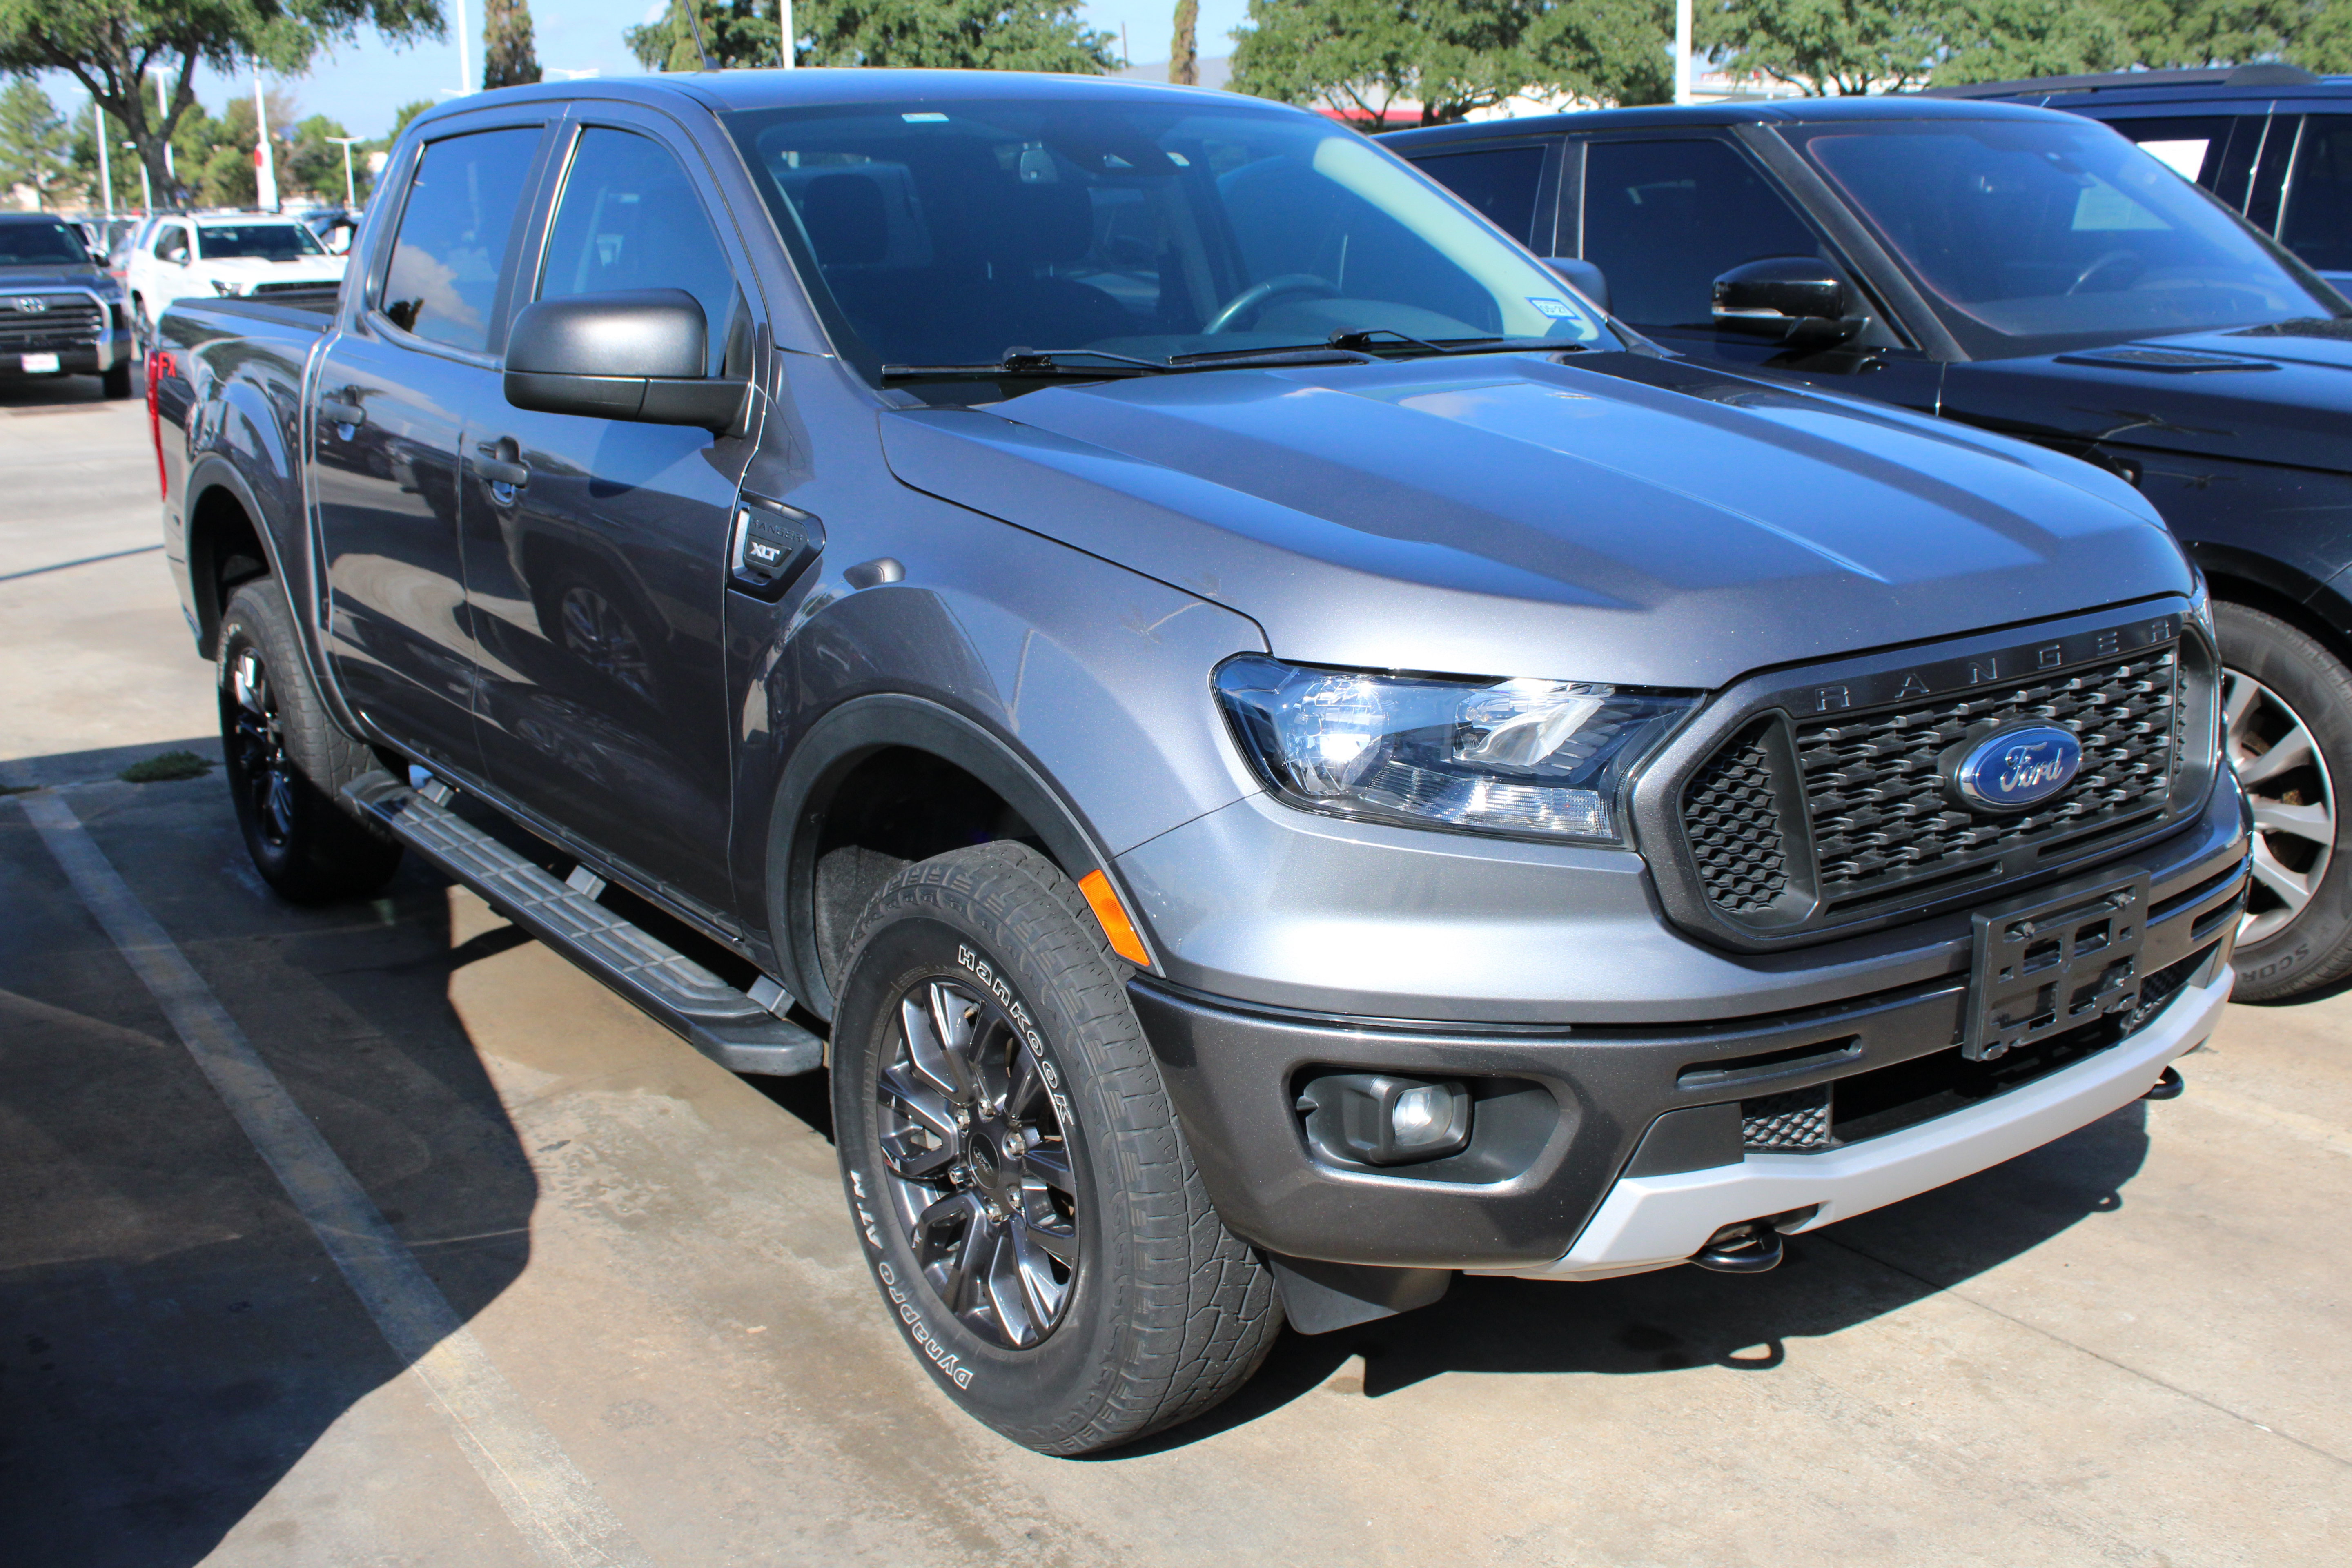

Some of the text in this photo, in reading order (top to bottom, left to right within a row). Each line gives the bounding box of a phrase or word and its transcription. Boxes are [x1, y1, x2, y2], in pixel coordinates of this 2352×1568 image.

[750, 519, 803, 542] RANGER
[750, 541, 780, 561] XLT
[1814, 620, 2171, 711] RANGER
[2000, 741, 2063, 792] Ford
[2241, 943, 2310, 982] SCOR
[879, 1262, 974, 1389] Dynapro
